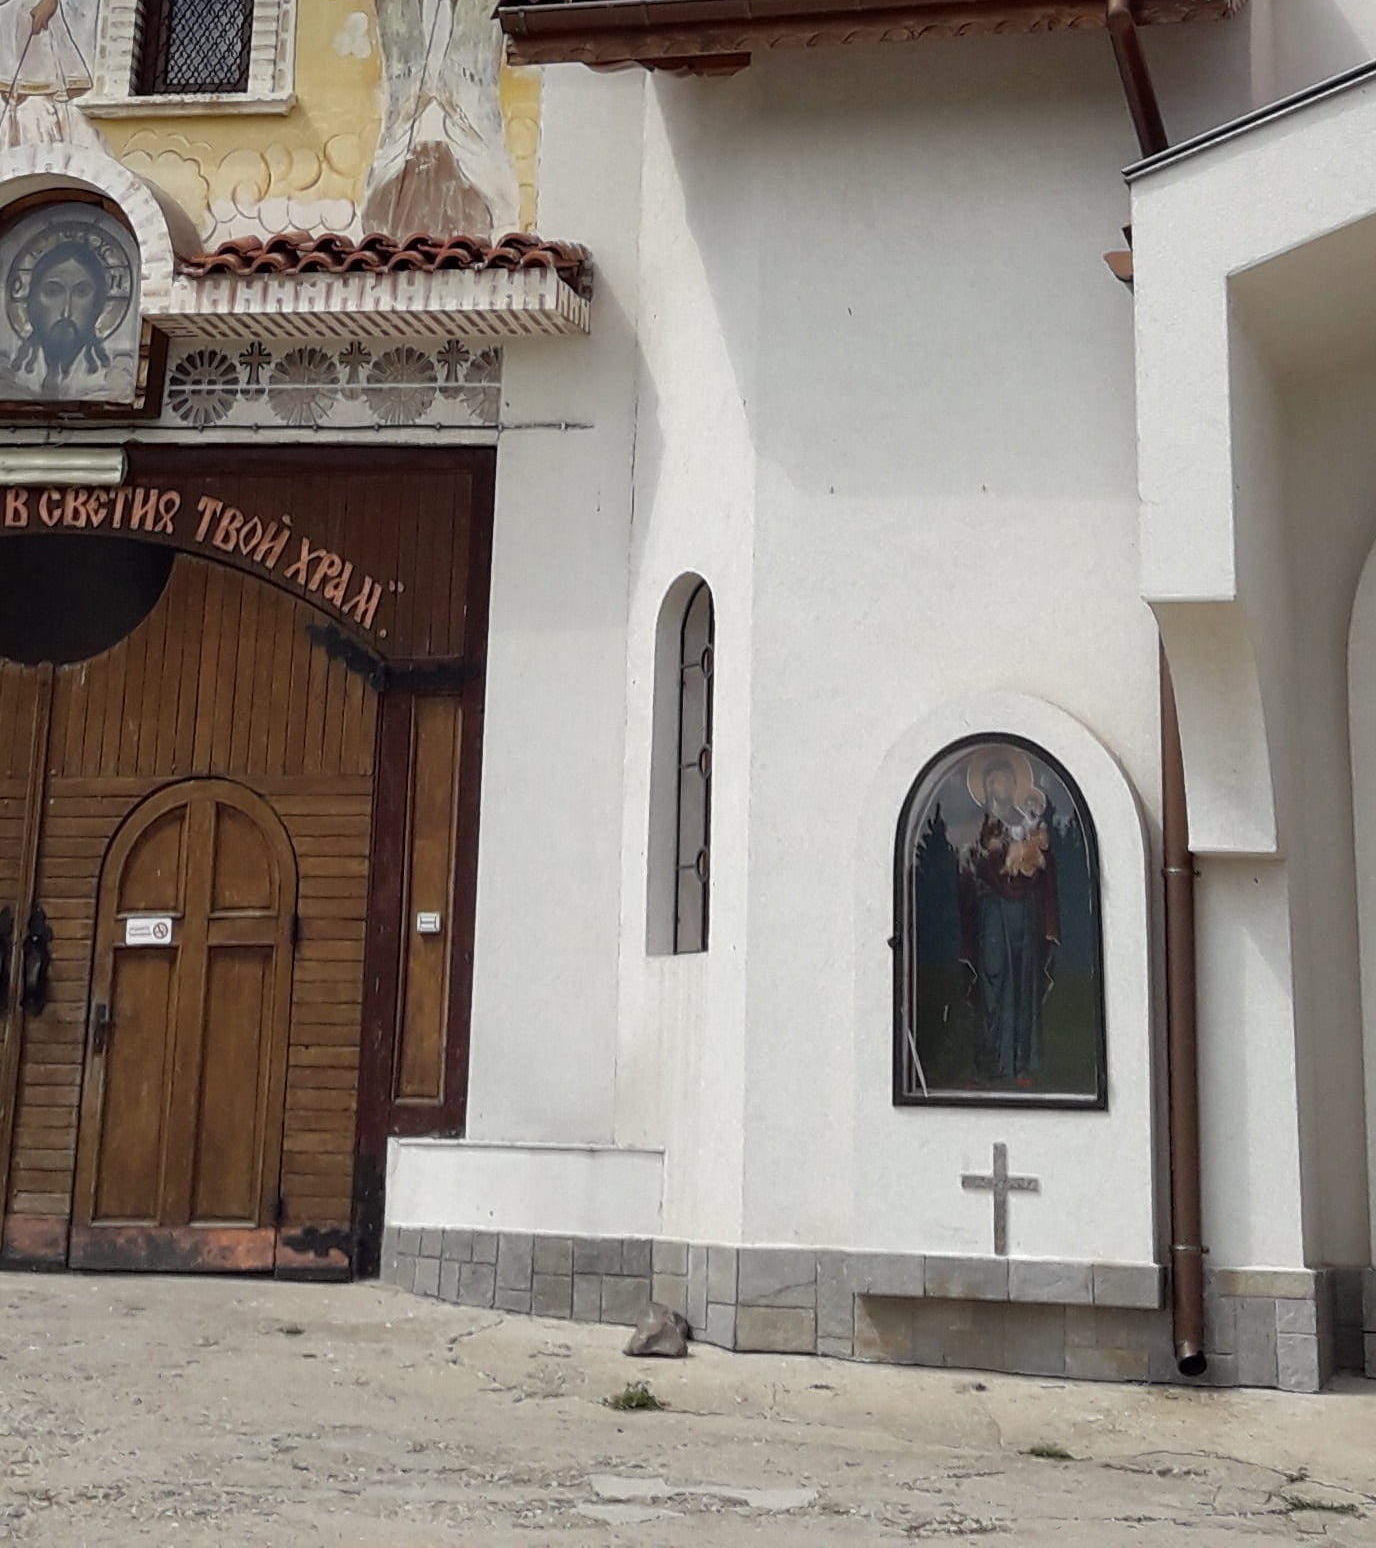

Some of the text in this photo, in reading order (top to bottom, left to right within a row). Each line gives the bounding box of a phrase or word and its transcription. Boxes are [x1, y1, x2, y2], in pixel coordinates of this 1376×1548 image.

[4, 487, 29, 529] В
[38, 486, 181, 535] СВЕТИЯ
[194, 495, 293, 570] ТВОЙ
